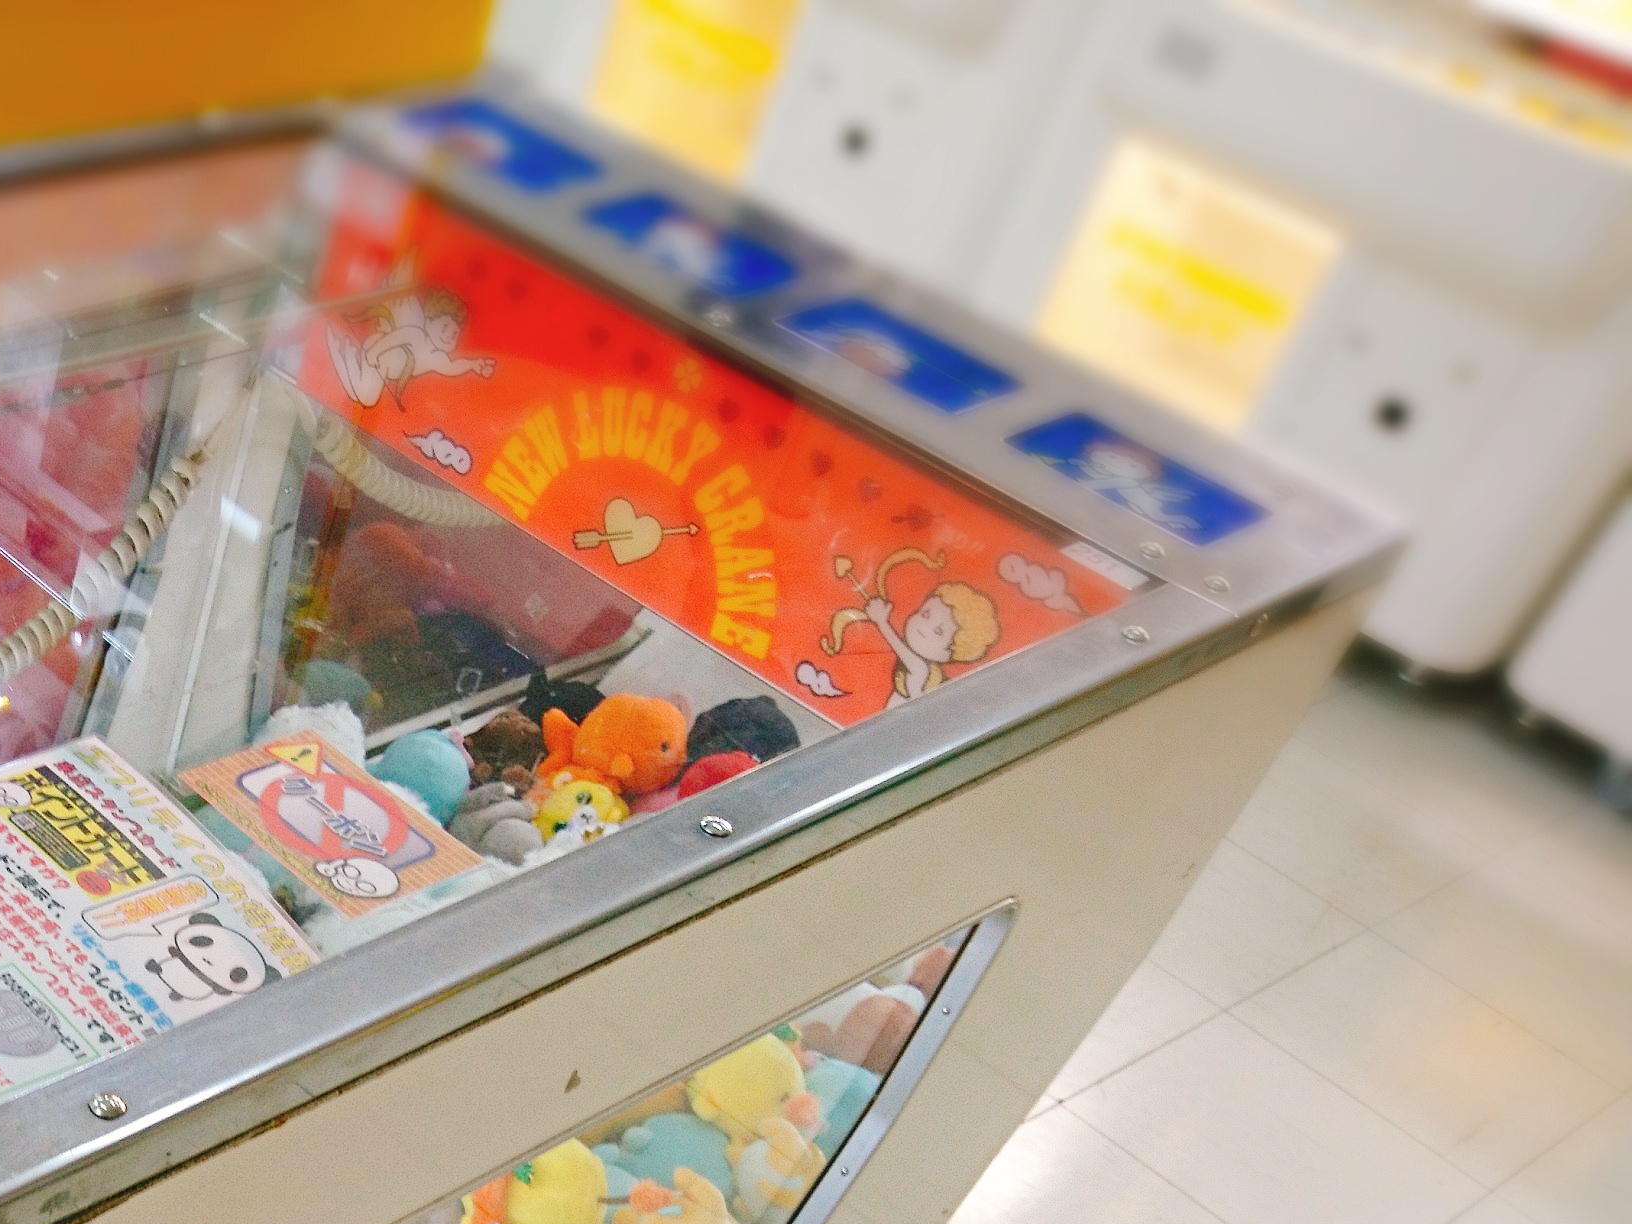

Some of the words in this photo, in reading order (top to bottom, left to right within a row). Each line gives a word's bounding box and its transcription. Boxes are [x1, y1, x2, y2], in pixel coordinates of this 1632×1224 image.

[483, 405, 569, 523] NEW
[573, 387, 722, 487] LUCKY
[692, 463, 778, 661] CRANE
[8, 770, 154, 889] ポイントカード
[279, 775, 389, 858] クーポン
